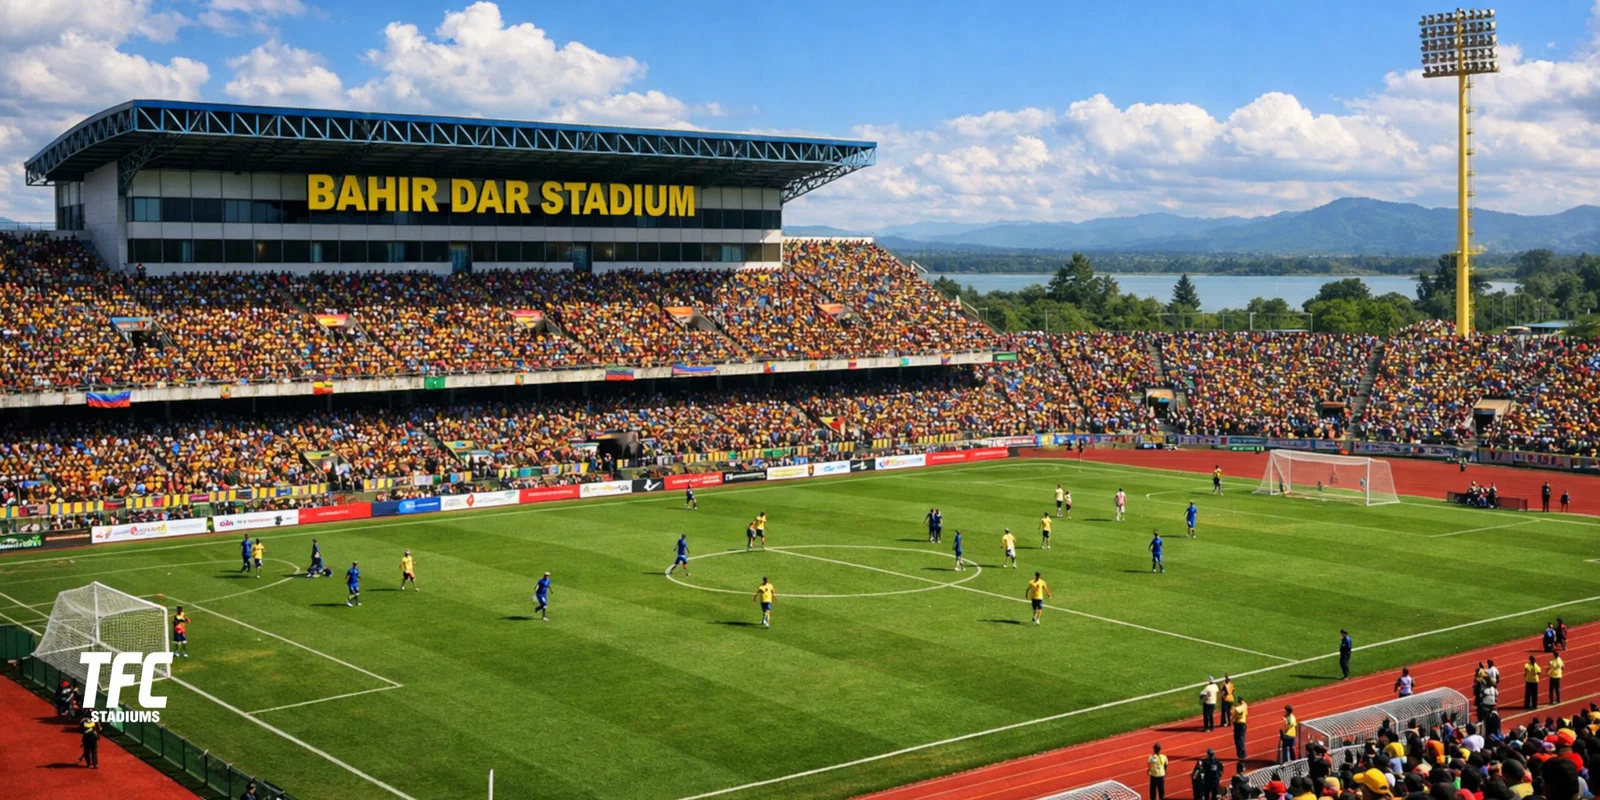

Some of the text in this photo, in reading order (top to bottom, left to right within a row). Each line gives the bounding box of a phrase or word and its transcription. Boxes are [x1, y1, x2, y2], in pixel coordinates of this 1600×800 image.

[307, 174, 695, 216] BAHIR DAR STADIUM
